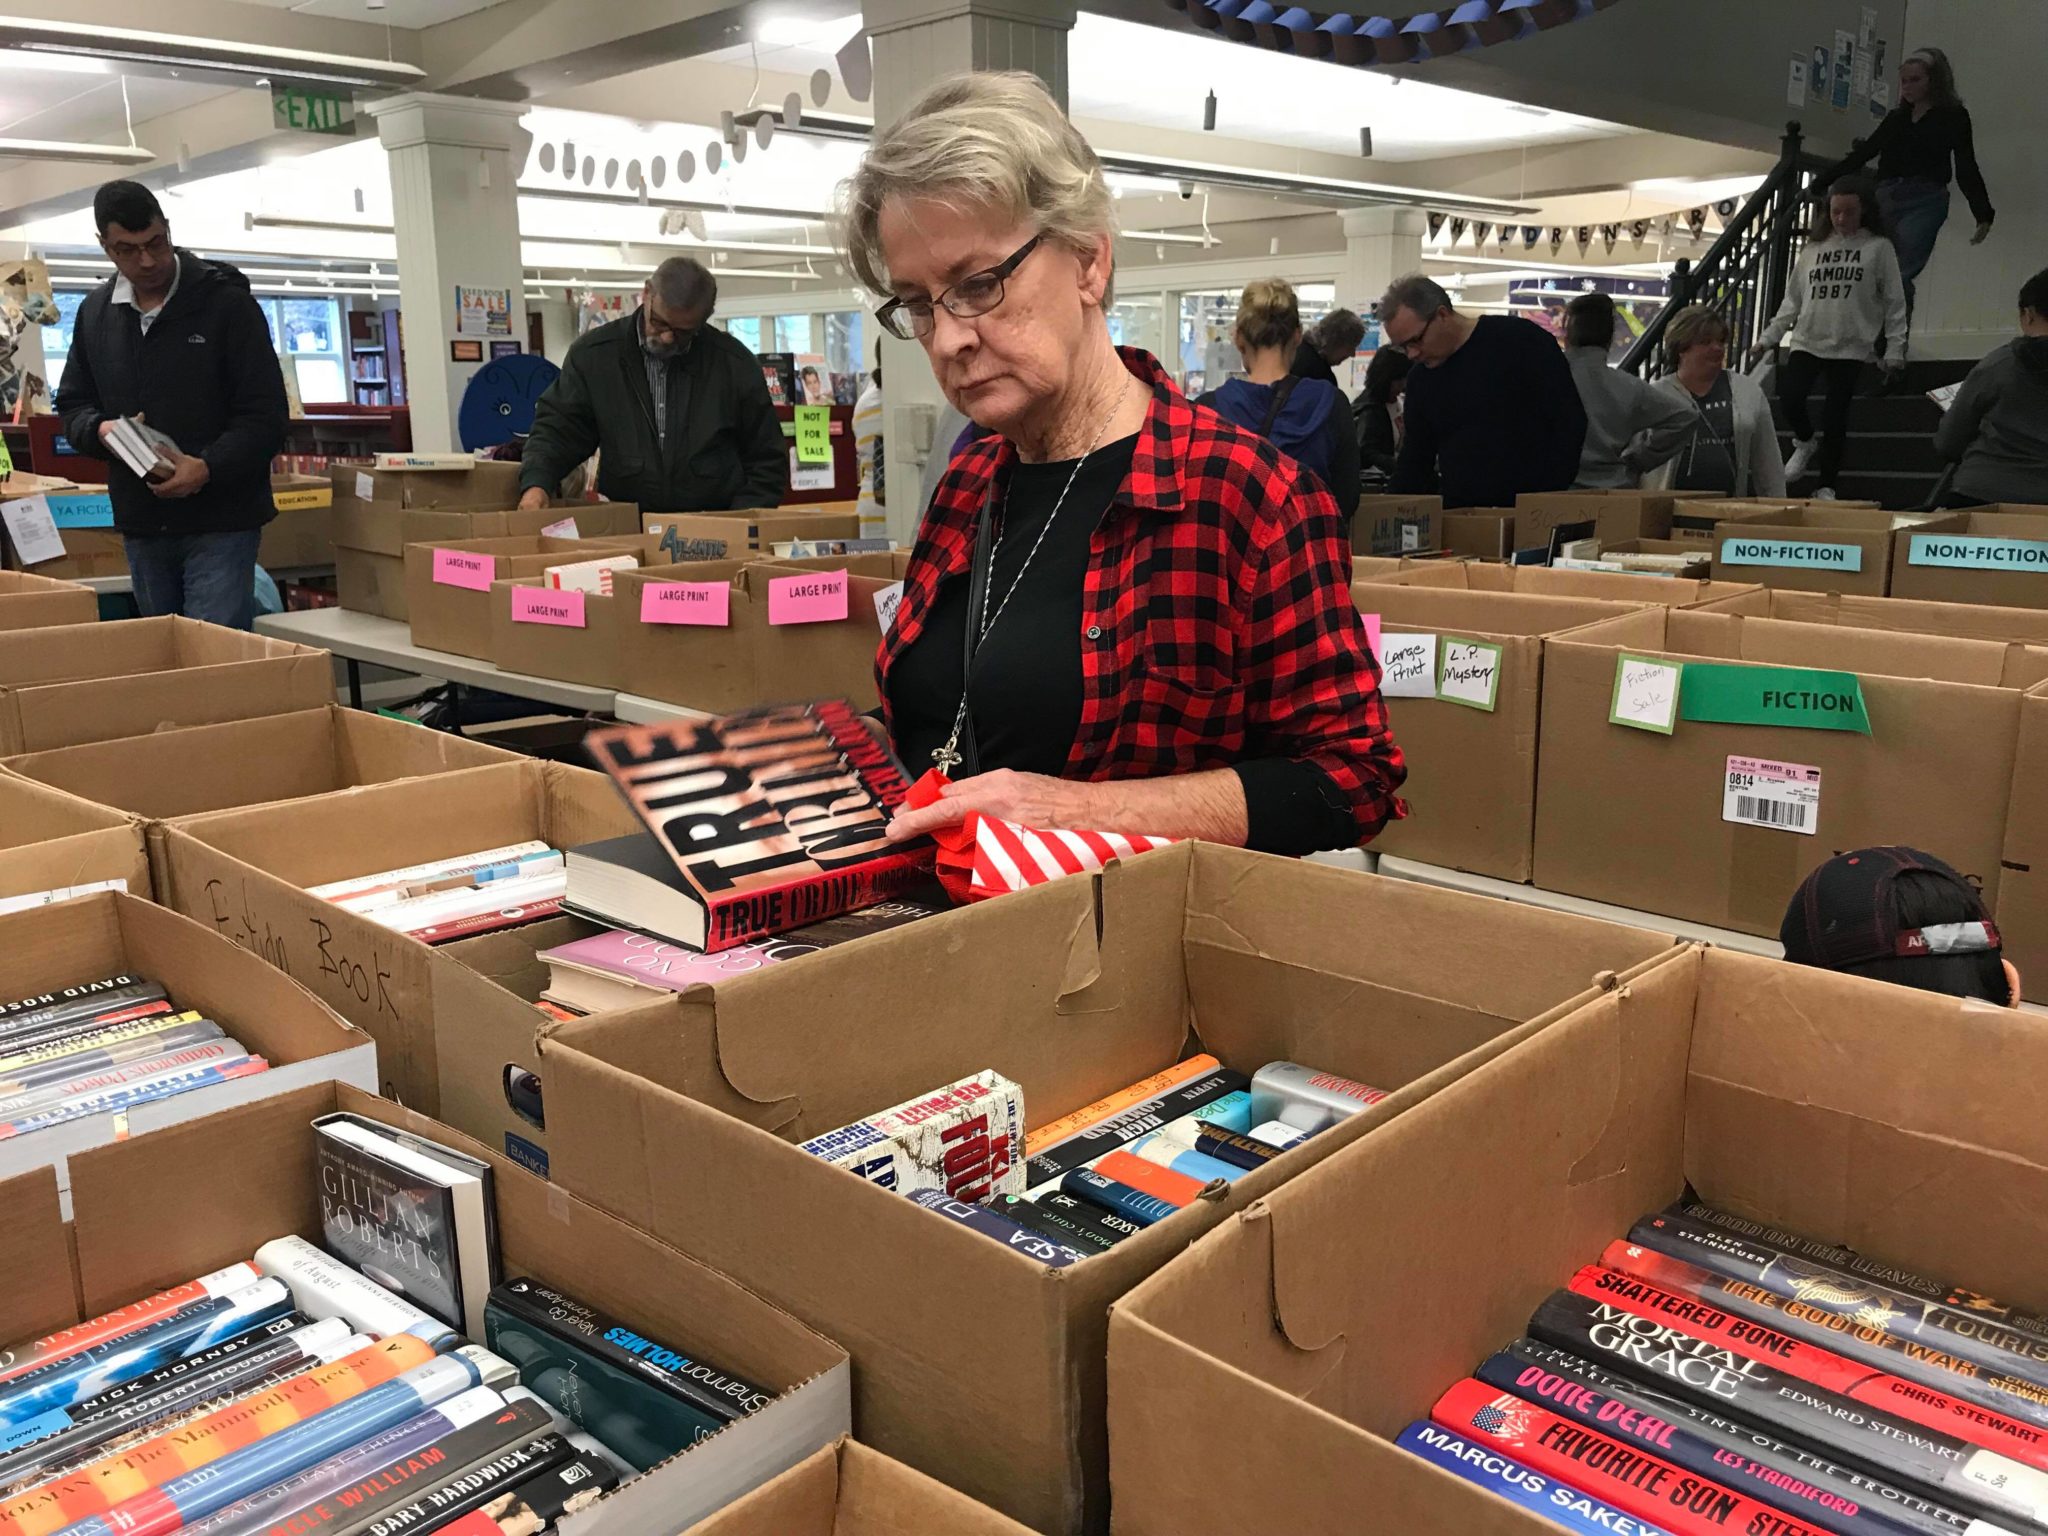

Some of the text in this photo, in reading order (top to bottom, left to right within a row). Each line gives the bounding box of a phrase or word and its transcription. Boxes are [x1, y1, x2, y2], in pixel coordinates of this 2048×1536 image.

[286, 88, 342, 129] EXIT
[1816, 249, 1861, 265] INSTA
[1809, 267, 1864, 284] FAMOUS
[463, 294, 505, 311] SALE
[1811, 285, 1853, 300] 1987
[804, 412, 820, 422] NOT
[805, 430, 820, 439] FOR
[804, 447, 824, 456] SALE
[56, 506, 74, 516] YA
[278, 495, 318, 505] EDUCATION
[445, 558, 481, 571] LARGE PRINT
[1735, 544, 1844, 562] NON-FICTION
[659, 590, 709, 602] LARGE PRINT
[789, 581, 842, 598] LARGE PRINT
[527, 604, 568, 618] LARGE PRINT
[1385, 644, 1426, 665] Large
[1386, 658, 1426, 682] Print
[1443, 665, 1494, 687] Mystery
[1626, 666, 1664, 688] Fiction
[1633, 691, 1667, 713] Sale
[1762, 691, 1854, 712] FICTION
[1729, 772, 1753, 786] 0814
[716, 884, 782, 942] TRUE
[310, 918, 399, 1021] Book
[622, 953, 675, 976] NO
[63, 975, 131, 997] DAVID
[1081, 1099, 1166, 1140] COMMAND
[1111, 1113, 1164, 1141] HIGH
[322, 1165, 434, 1242] GILLIAN
[322, 1195, 440, 1279] ROBERTS
[1008, 1229, 1057, 1261] SEA
[1677, 1230, 1767, 1265] STEINHAUER
[1684, 1204, 1945, 1297] BLOOD ON THE LEAVES
[1706, 1231, 1744, 1248] OLEN
[306, 1266, 341, 1290] August
[33, 1280, 197, 1351] ALYSON HAGY
[534, 1287, 596, 1320] Home Again
[1595, 1273, 1800, 1359] SHATTERED BONE
[98, 1325, 150, 1353] Jules
[154, 1297, 217, 1330] Hardy
[548, 1306, 600, 1336] Never Go
[1722, 1279, 1979, 1377] THE GOD OF WAR
[1588, 1303, 1769, 1383] MORTAL
[82, 1336, 250, 1410] NICK HORNBY
[602, 1326, 771, 1413] Shannon HOLMES
[1525, 1345, 1609, 1384] STEWART
[1551, 1349, 1600, 1371] MIKE
[1588, 1323, 1745, 1400] GRACE
[117, 1348, 279, 1419] ROBERT HOUGH
[115, 1444, 170, 1471] The
[172, 1390, 293, 1447] Mammoth
[293, 1357, 371, 1394] Cheese
[1515, 1365, 1680, 1449] DONE DEAL
[1891, 1382, 2042, 1445] CHRIS STEWART
[6, 1424, 43, 1444] DOWN
[1778, 1386, 1966, 1464] EDWARD STEWART
[336, 1446, 447, 1508] WILLIAM
[1416, 1426, 1662, 1536] MARCUS SAKEY
[1536, 1421, 1743, 1527] FAVORITE SON
[1688, 1407, 1960, 1526] SINS OF THE BROTHER
[1713, 1448, 1860, 1517] LES STANDIFORD
[369, 1448, 533, 1536] GARY HARDWICK
